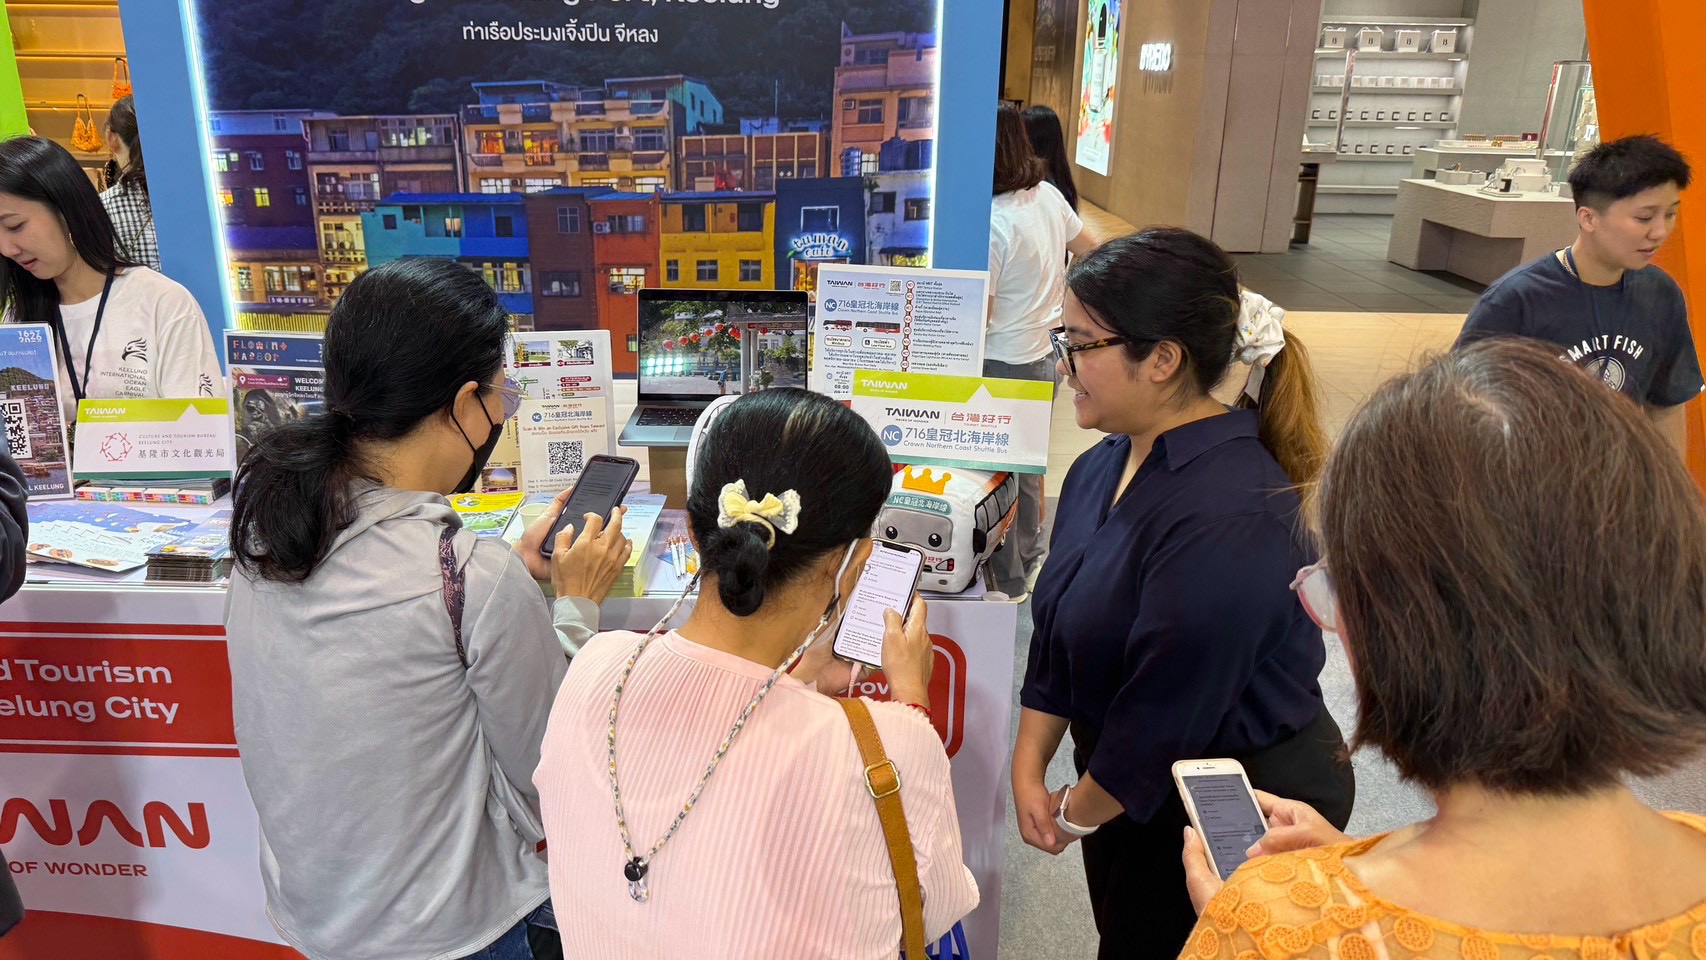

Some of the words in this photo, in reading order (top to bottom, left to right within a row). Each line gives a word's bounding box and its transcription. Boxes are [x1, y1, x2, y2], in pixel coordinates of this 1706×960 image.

[615, 24, 659, 43] จีหลง
[1613, 335, 1644, 360] FISH
[100, 371, 147, 380] INTERNATIONAL
[10, 383, 50, 391] KEELUNG
[861, 379, 908, 390] TAIWAN
[84, 407, 126, 415] TAIWAN
[885, 407, 940, 420] TAIWAN
[951, 411, 1012, 425] 台灣好行
[883, 430, 900, 441] NC
[905, 427, 1010, 446] 716皇冠北海岸線
[138, 448, 225, 458] 基隆市文化觀光局
[903, 440, 925, 448] Crown
[926, 442, 953, 450] Northern
[974, 445, 995, 453] Shuttle
[34, 483, 65, 491] KEELUNG
[14, 658, 172, 685] Tourism
[0, 695, 97, 723] elung
[104, 696, 179, 724] City
[8, 861, 38, 874] OF
[44, 861, 149, 877] WONDER
